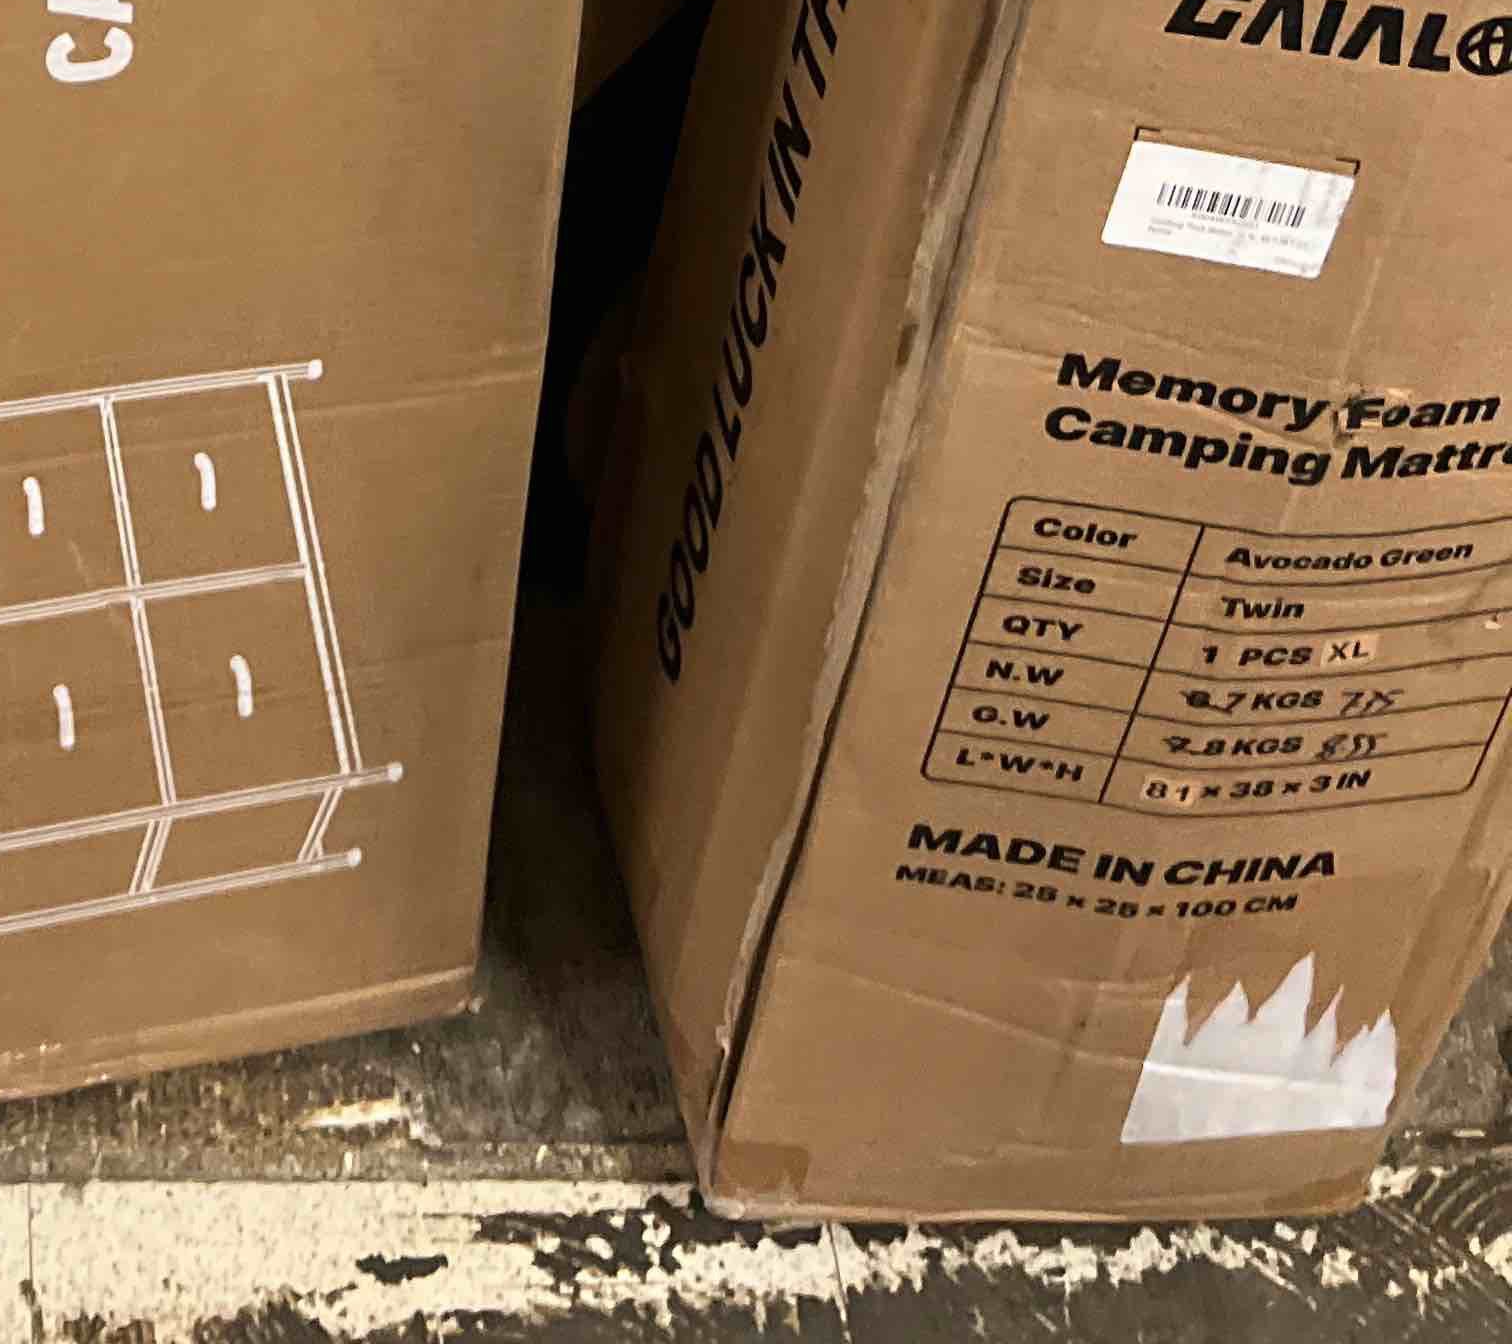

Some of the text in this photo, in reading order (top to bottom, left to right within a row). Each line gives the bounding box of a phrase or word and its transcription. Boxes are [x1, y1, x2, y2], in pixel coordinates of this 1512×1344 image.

[656, 431, 724, 684] GOOD
[712, 183, 786, 462] LUCK
[767, 80, 812, 224] IN
[1055, 352, 1502, 433] Memory Foam
[1044, 406, 1332, 488] Camping
[1032, 517, 1474, 572] Color Avocado Green
[1016, 565, 1305, 621] Size Twin
[1001, 614, 1370, 667] QTY 1 PCS XL
[984, 658, 1065, 687] N.W
[906, 823, 1337, 888] MADE IN CHINA
[894, 863, 1007, 896] MEAS:
[1175, 896, 1237, 919] 100
[1241, 893, 1299, 914] CM
